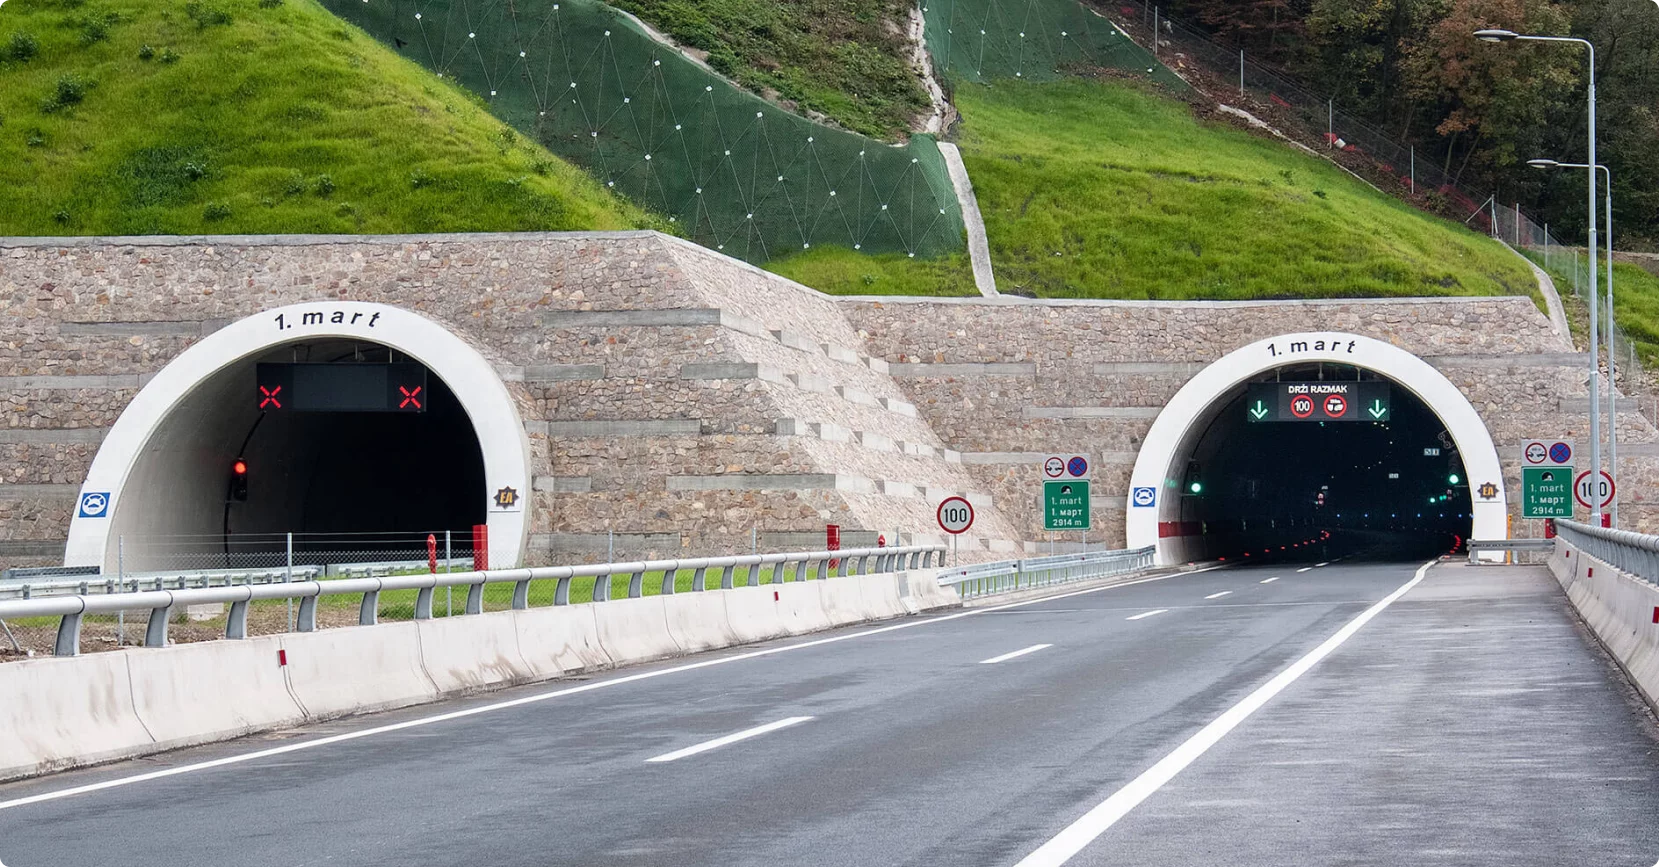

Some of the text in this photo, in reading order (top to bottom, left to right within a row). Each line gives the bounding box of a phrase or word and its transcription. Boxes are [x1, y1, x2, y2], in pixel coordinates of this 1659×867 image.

[274, 311, 380, 330] 1. mart
[1267, 340, 1355, 357] 1. mart
[1310, 385, 1347, 393] RAZMAK
[1294, 400, 1310, 411] 100
[1530, 484, 1564, 492] 1. mart
[500, 491, 513, 503] EA
[1051, 497, 1082, 505] 1. mart
[1530, 495, 1564, 505] 1. март
[944, 508, 967, 523] 100
[1051, 508, 1083, 518] 1. март
[1532, 506, 1554, 515] 2914
[1052, 519, 1073, 527] 2914
